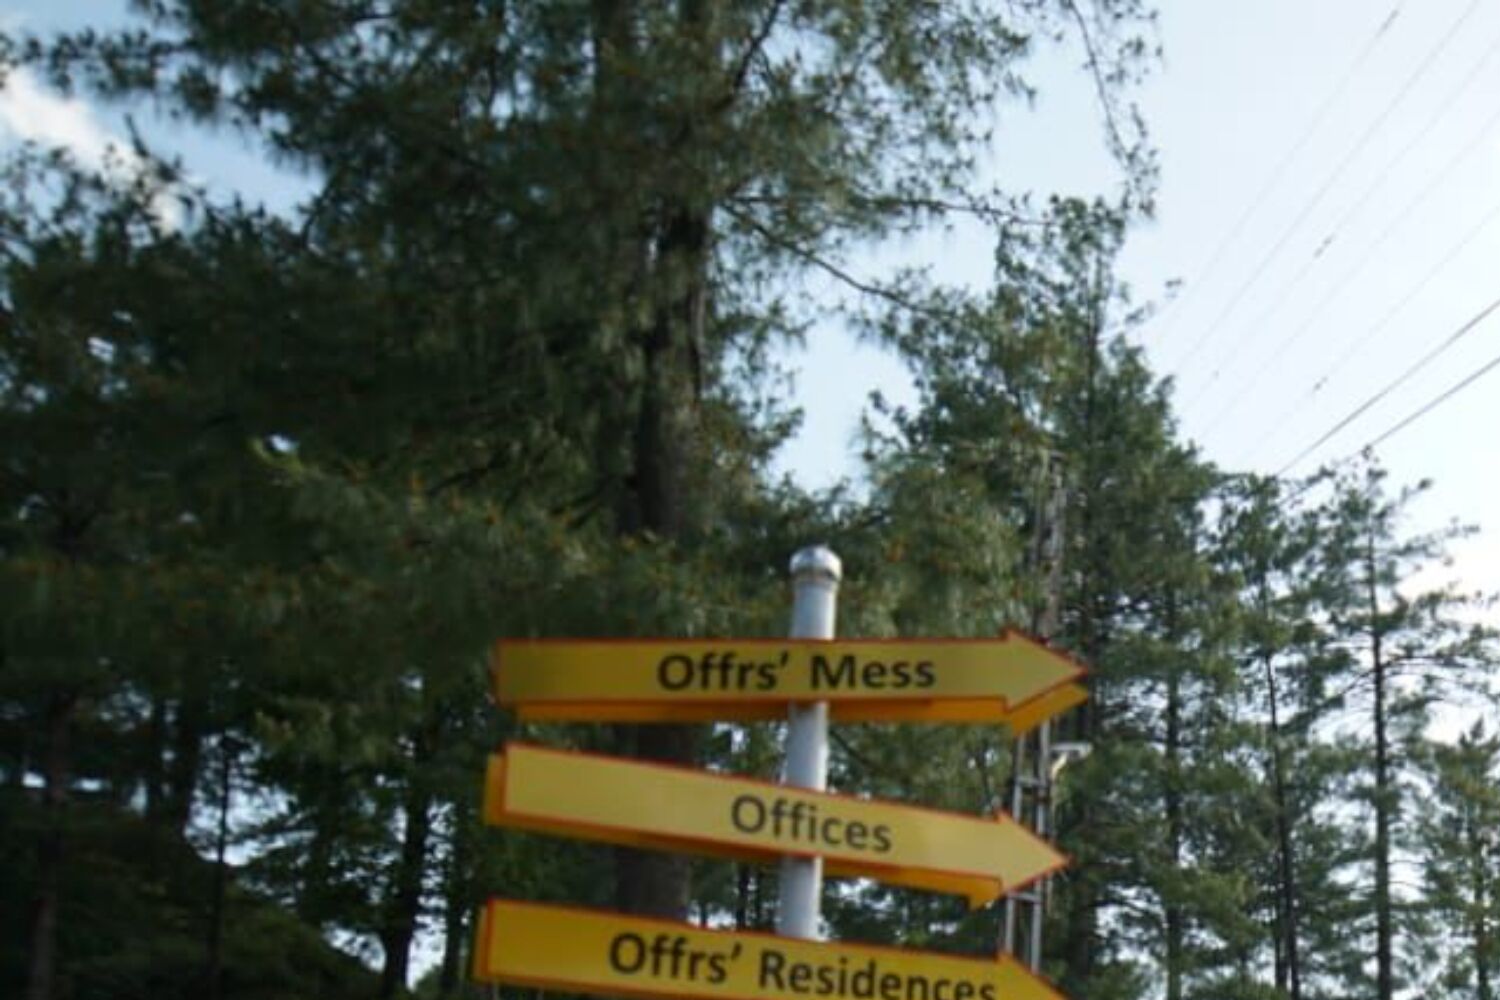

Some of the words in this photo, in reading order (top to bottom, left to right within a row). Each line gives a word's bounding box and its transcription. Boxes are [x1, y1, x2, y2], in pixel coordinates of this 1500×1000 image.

[656, 652, 791, 692] Offrs'
[809, 653, 937, 690] Mess
[730, 793, 894, 854] Offices
[607, 931, 743, 985] Offrs'
